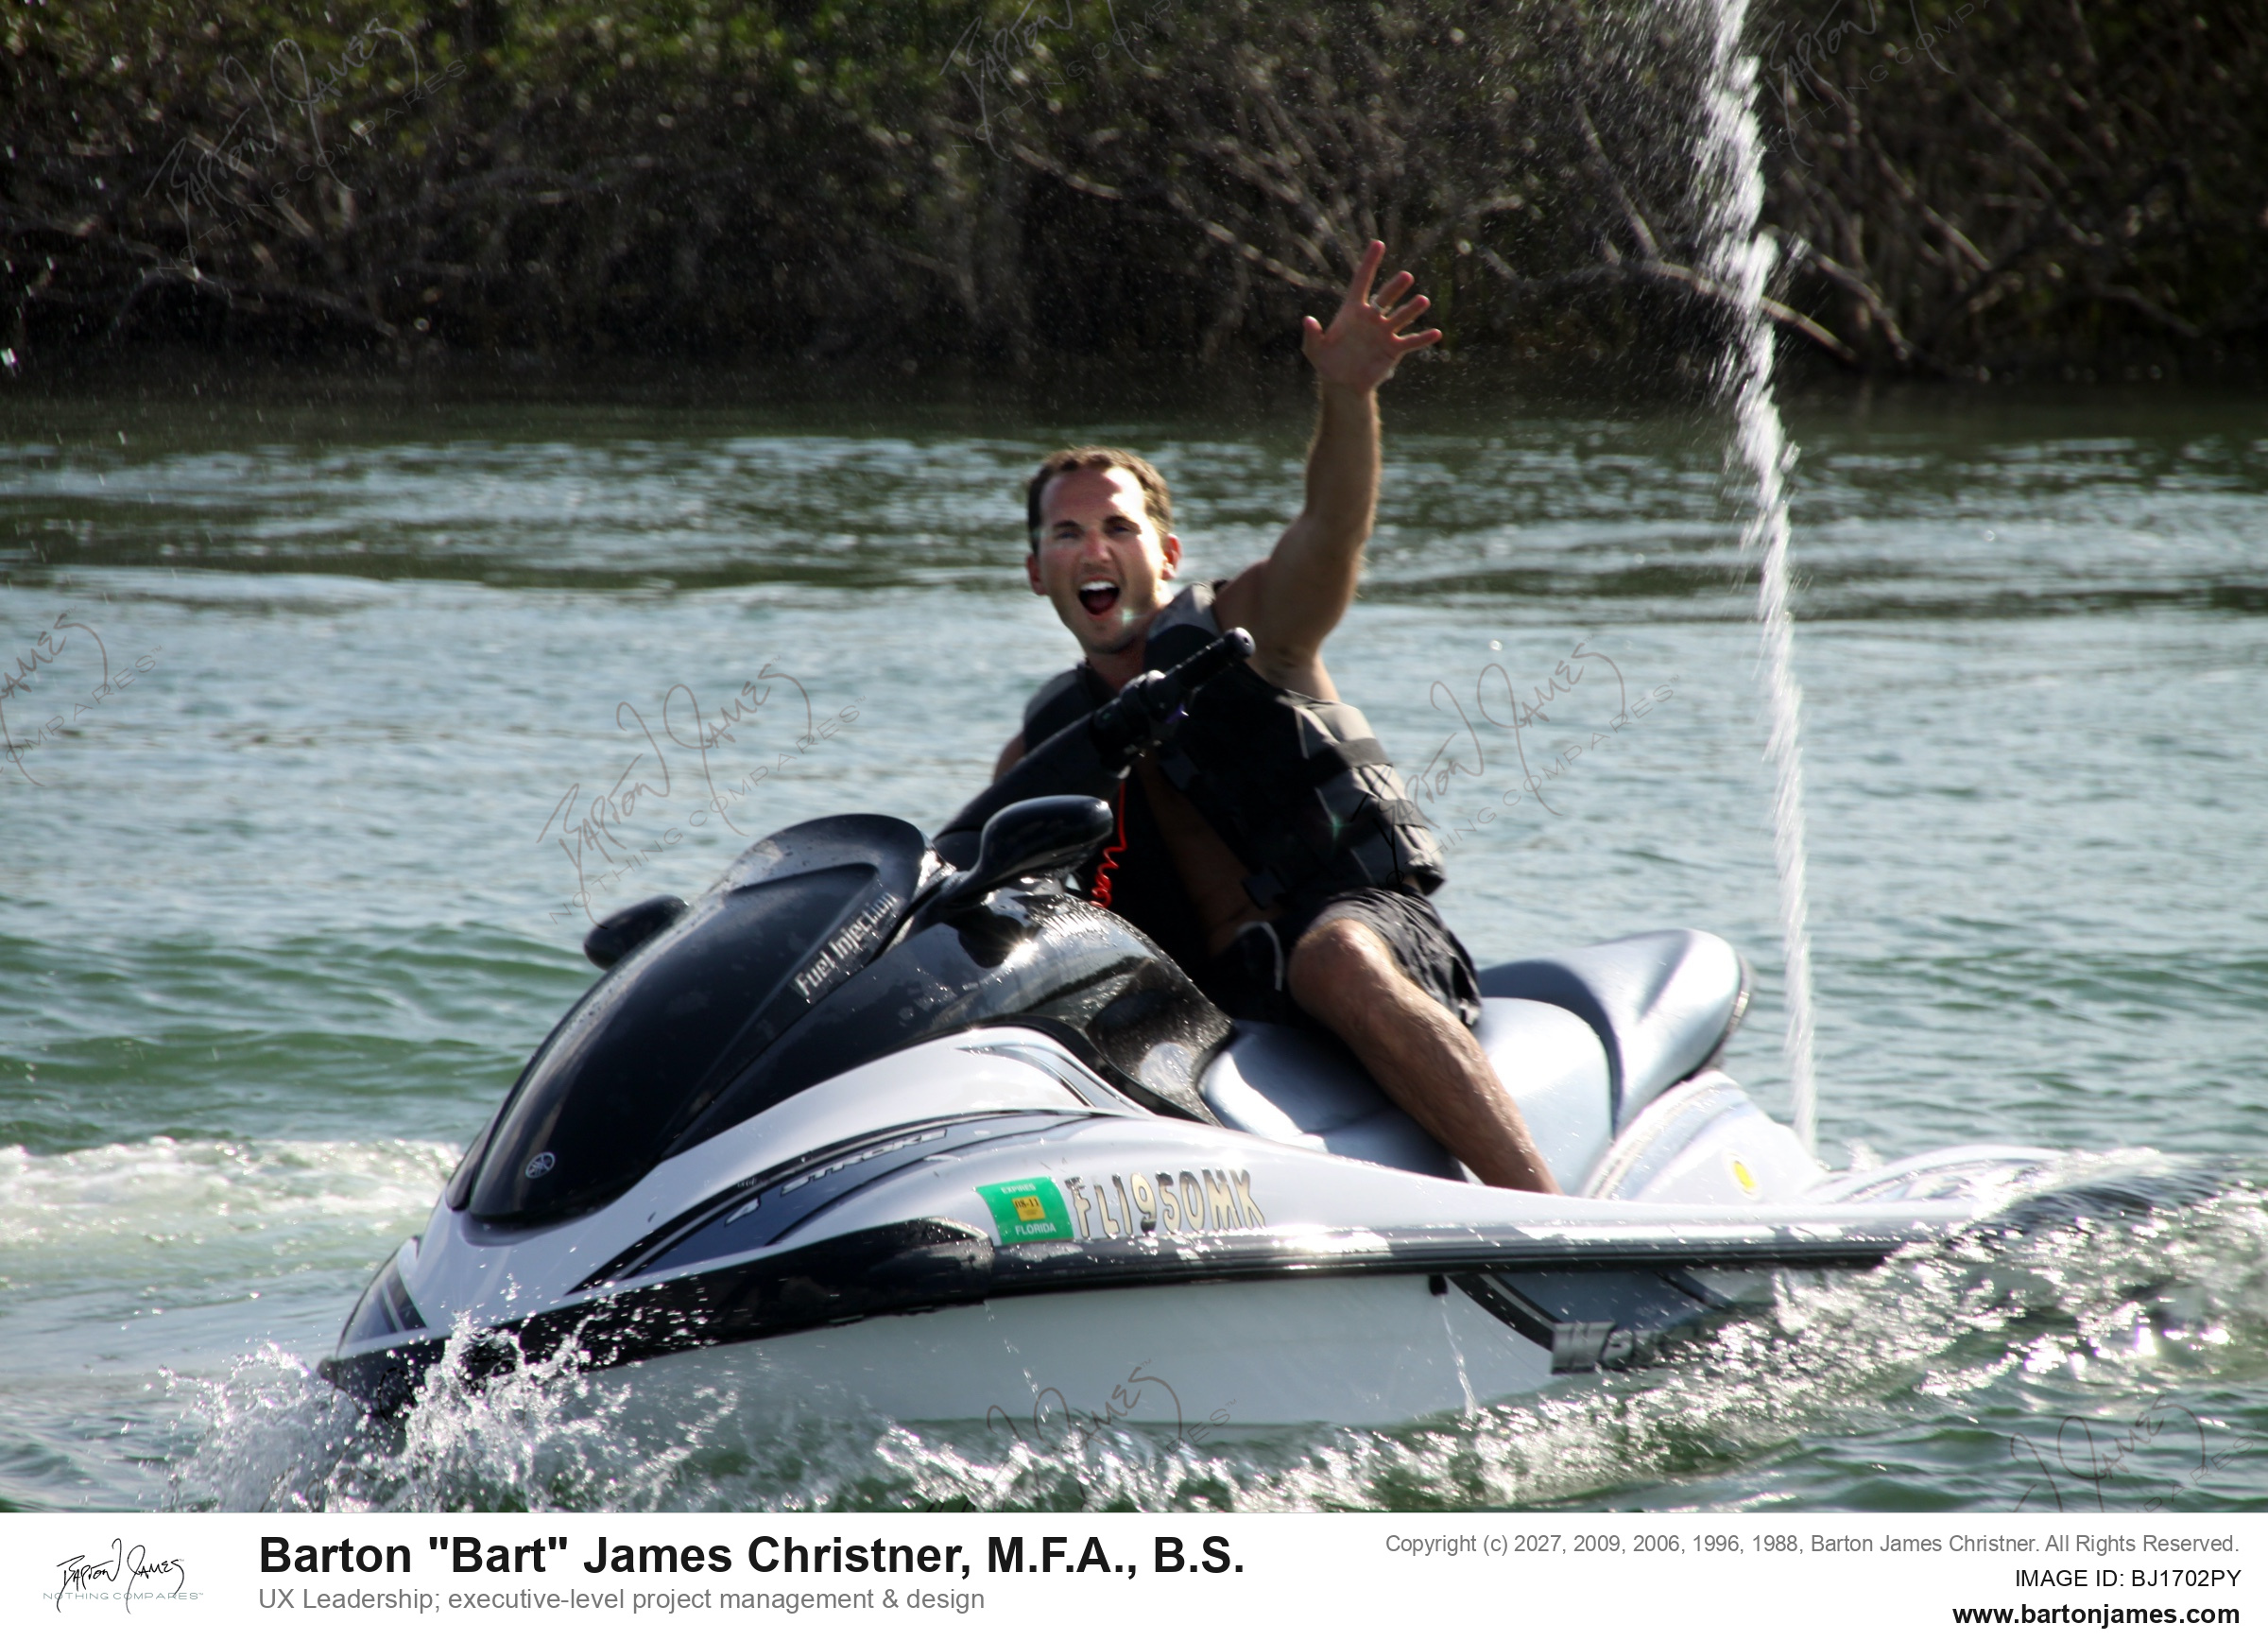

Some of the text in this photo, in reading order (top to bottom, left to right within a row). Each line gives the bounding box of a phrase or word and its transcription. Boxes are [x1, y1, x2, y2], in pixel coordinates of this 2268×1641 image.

[794, 949, 836, 997] Fuel
[1000, 1183, 1037, 1194] EXPIRES
[1014, 1222, 1057, 1235] FLORIDA
